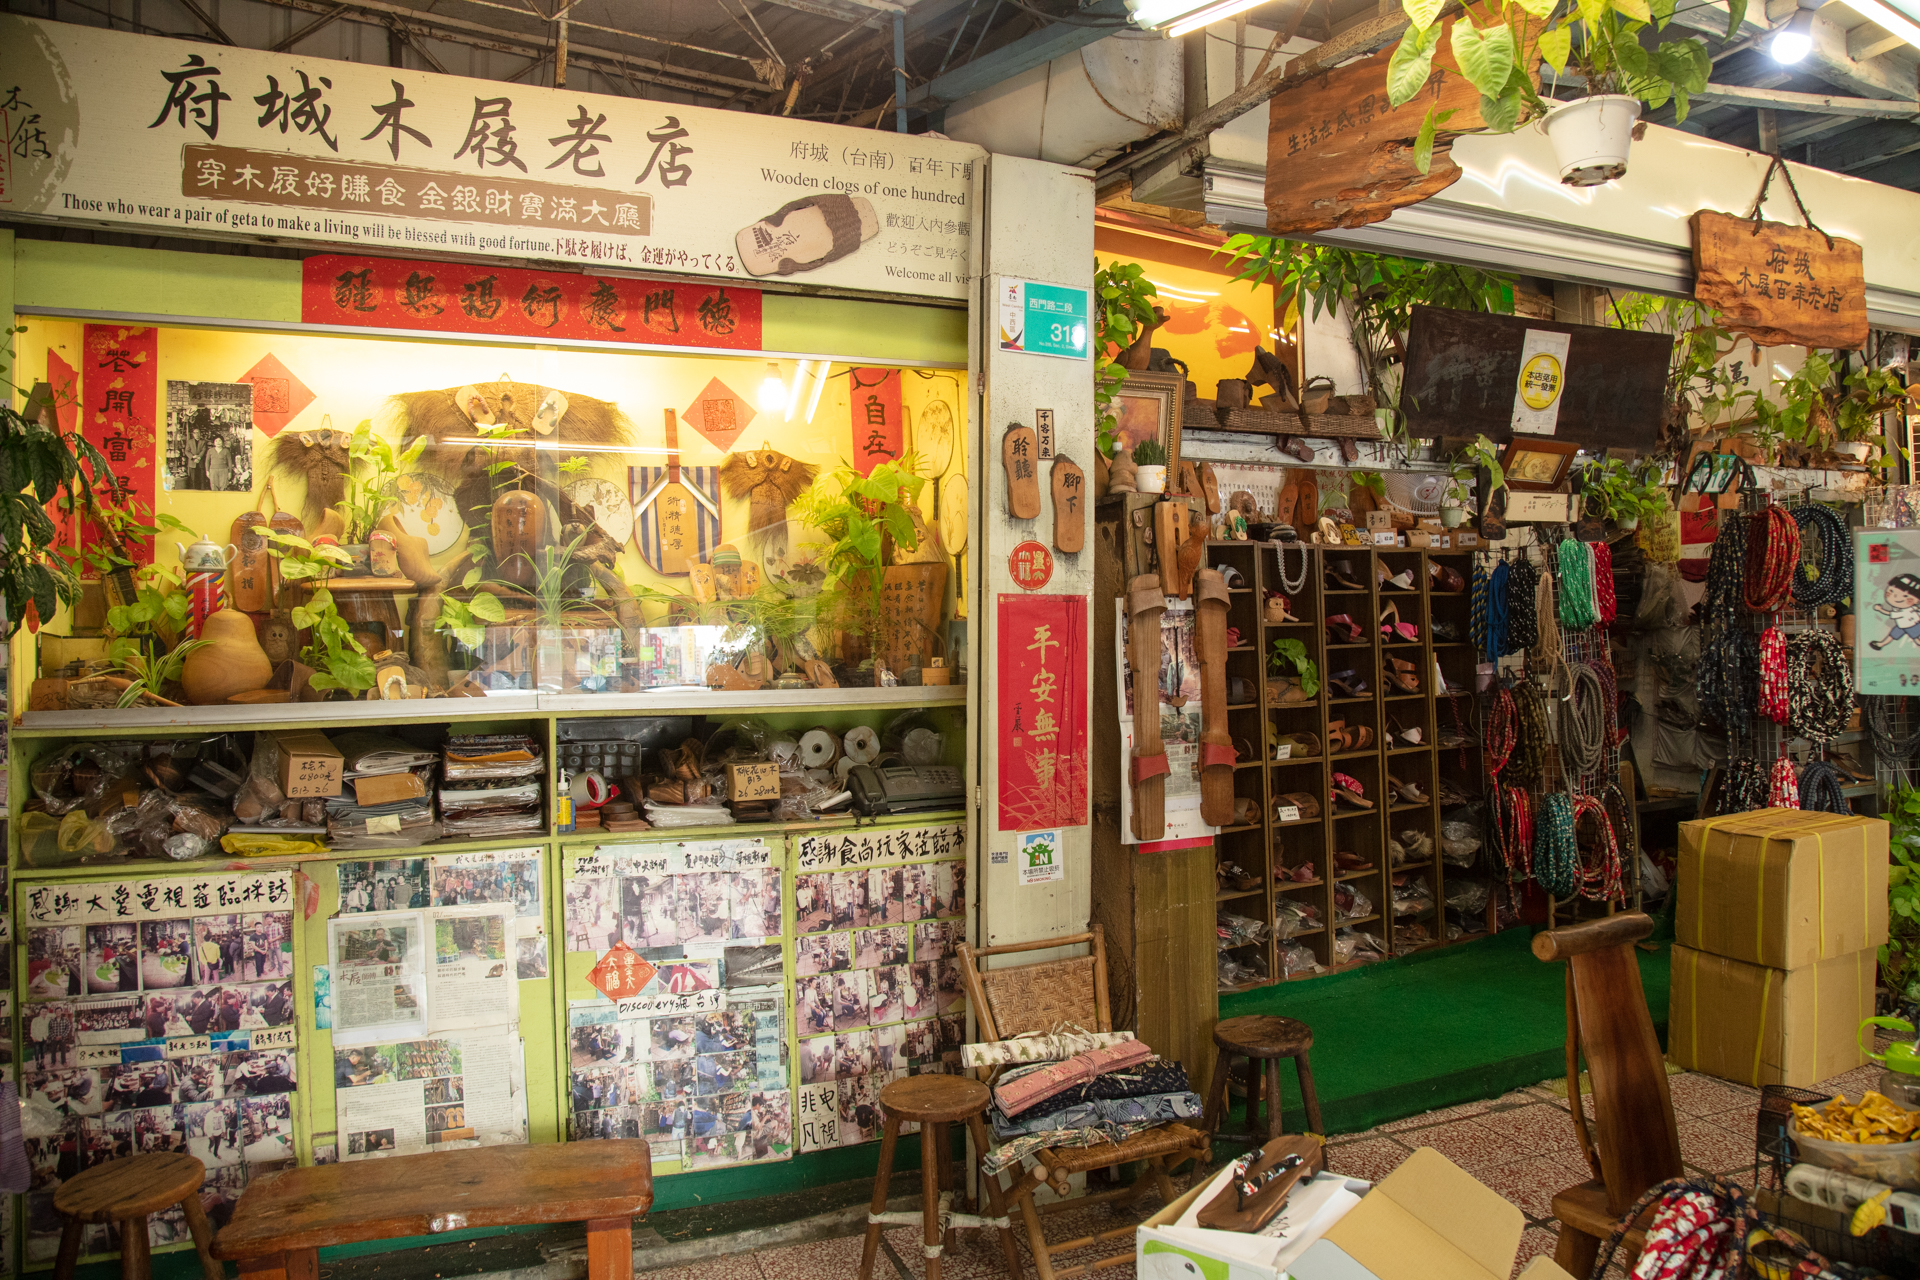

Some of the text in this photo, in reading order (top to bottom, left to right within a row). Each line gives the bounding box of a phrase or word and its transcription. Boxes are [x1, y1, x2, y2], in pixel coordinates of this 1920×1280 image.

[147, 54, 693, 189] 府城木屐老店
[1287, 69, 1448, 156] 生活在感恩的界
[197, 158, 641, 230] 穿木屐好賺食 金銀財寶滿大廳
[760, 168, 966, 206] Wooden clogs of one hundred
[62, 193, 555, 253] Those who wear a pair of geta to make a living will be blessed with good fortune.
[885, 266, 936, 281] Welcome
[938, 271, 952, 283] all
[1766, 244, 1816, 281] 府城
[1029, 298, 1073, 314] 西門路二段
[1524, 380, 1557, 392] 統一發票
[1526, 371, 1558, 384] 本店免用
[1012, 437, 1033, 481] 聆聽
[1063, 472, 1081, 514] 腳下
[1026, 624, 1060, 789] 平安無事
[315, 783, 328, 794] 26
[738, 789, 748, 798] 26
[1022, 865, 1060, 876] 本場所禁止吸菸
[801, 1090, 819, 1147] 非凡
